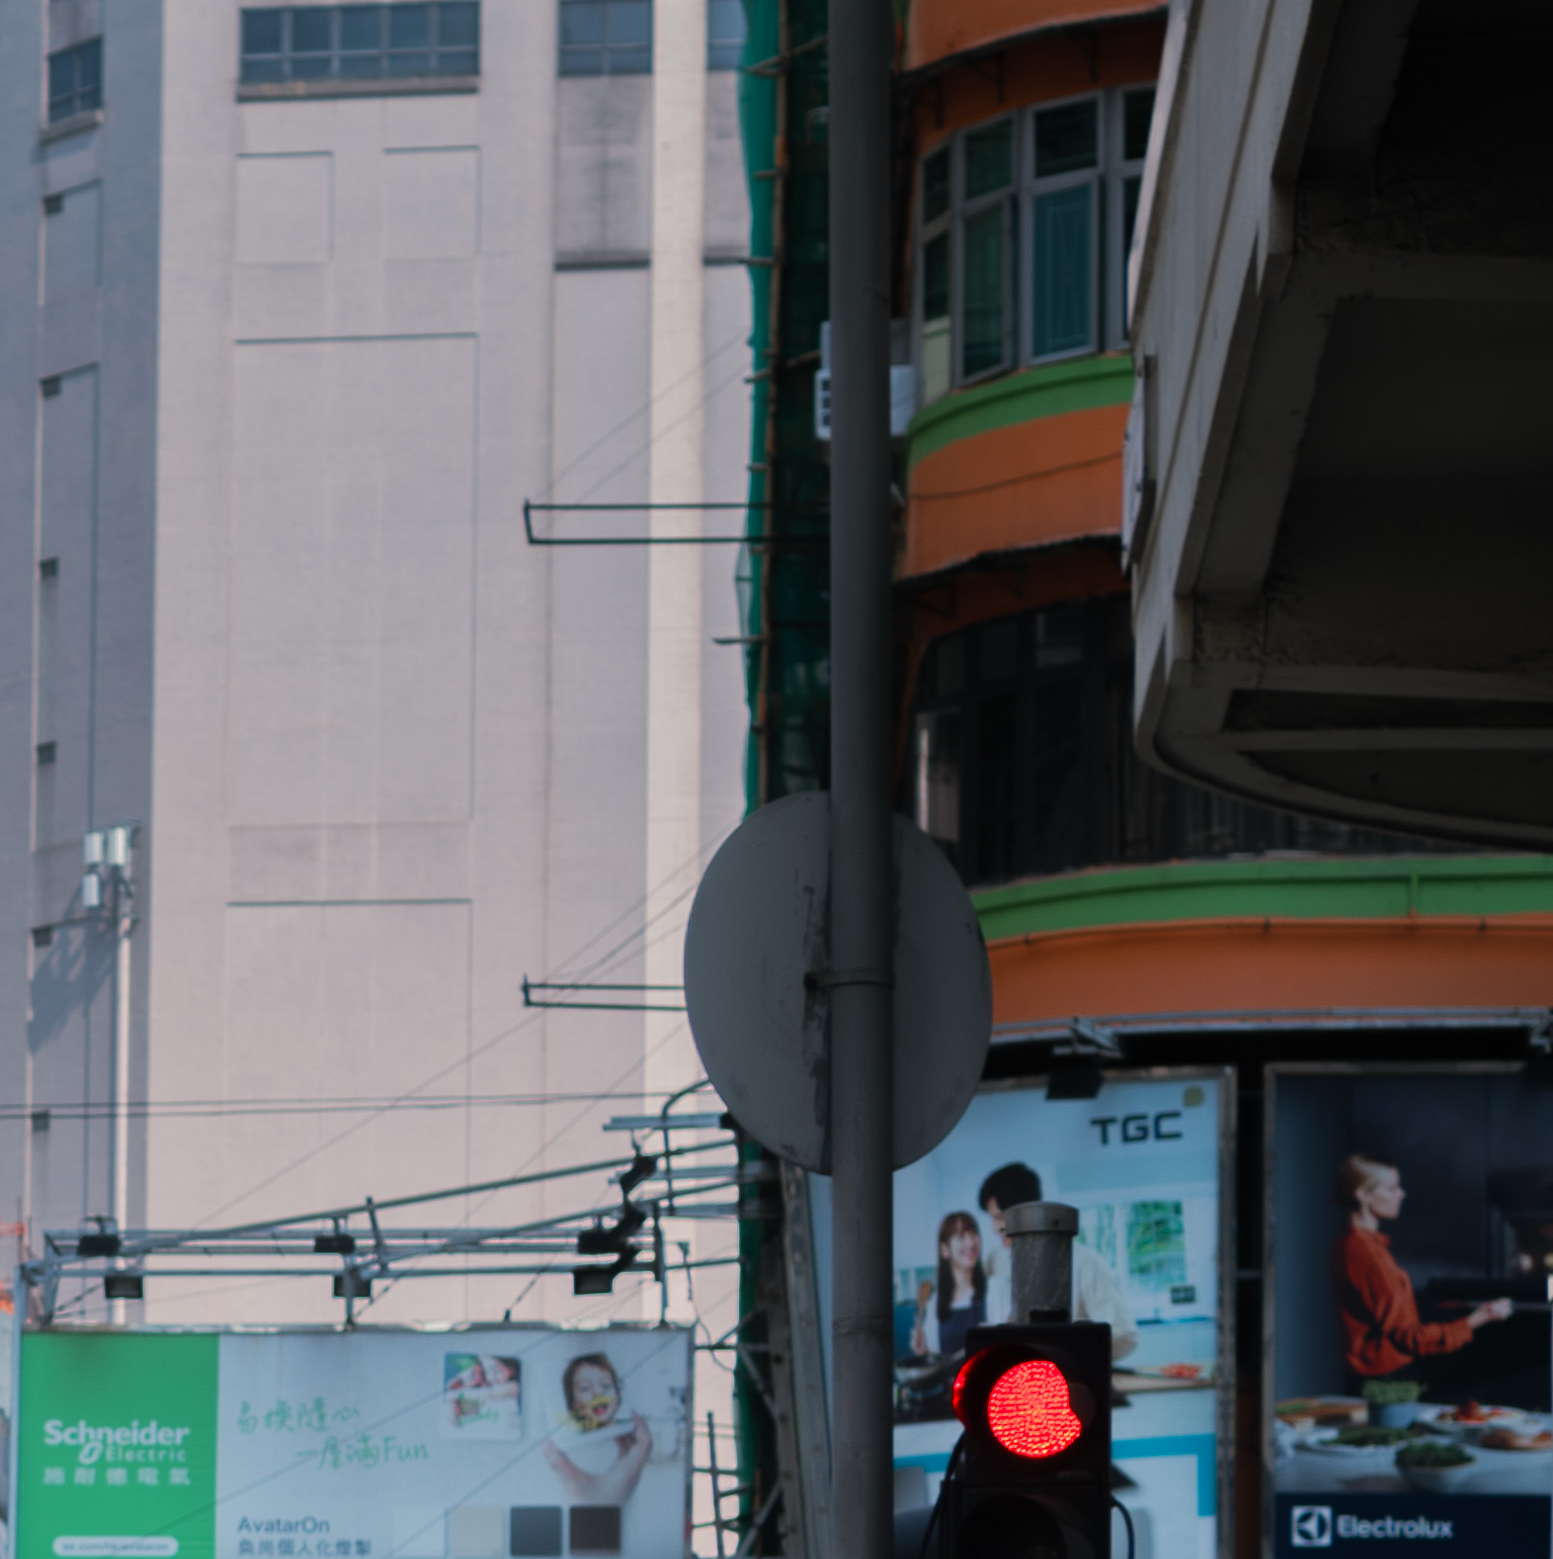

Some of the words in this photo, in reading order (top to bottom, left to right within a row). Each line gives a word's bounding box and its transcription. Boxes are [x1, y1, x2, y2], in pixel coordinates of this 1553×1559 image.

[1090, 1110, 1184, 1146] TGC
[43, 1418, 191, 1447] Schneider
[105, 1445, 187, 1463] Electric
[237, 1515, 331, 1534] AvatarOn
[1336, 1515, 1453, 1539] Electrolux
